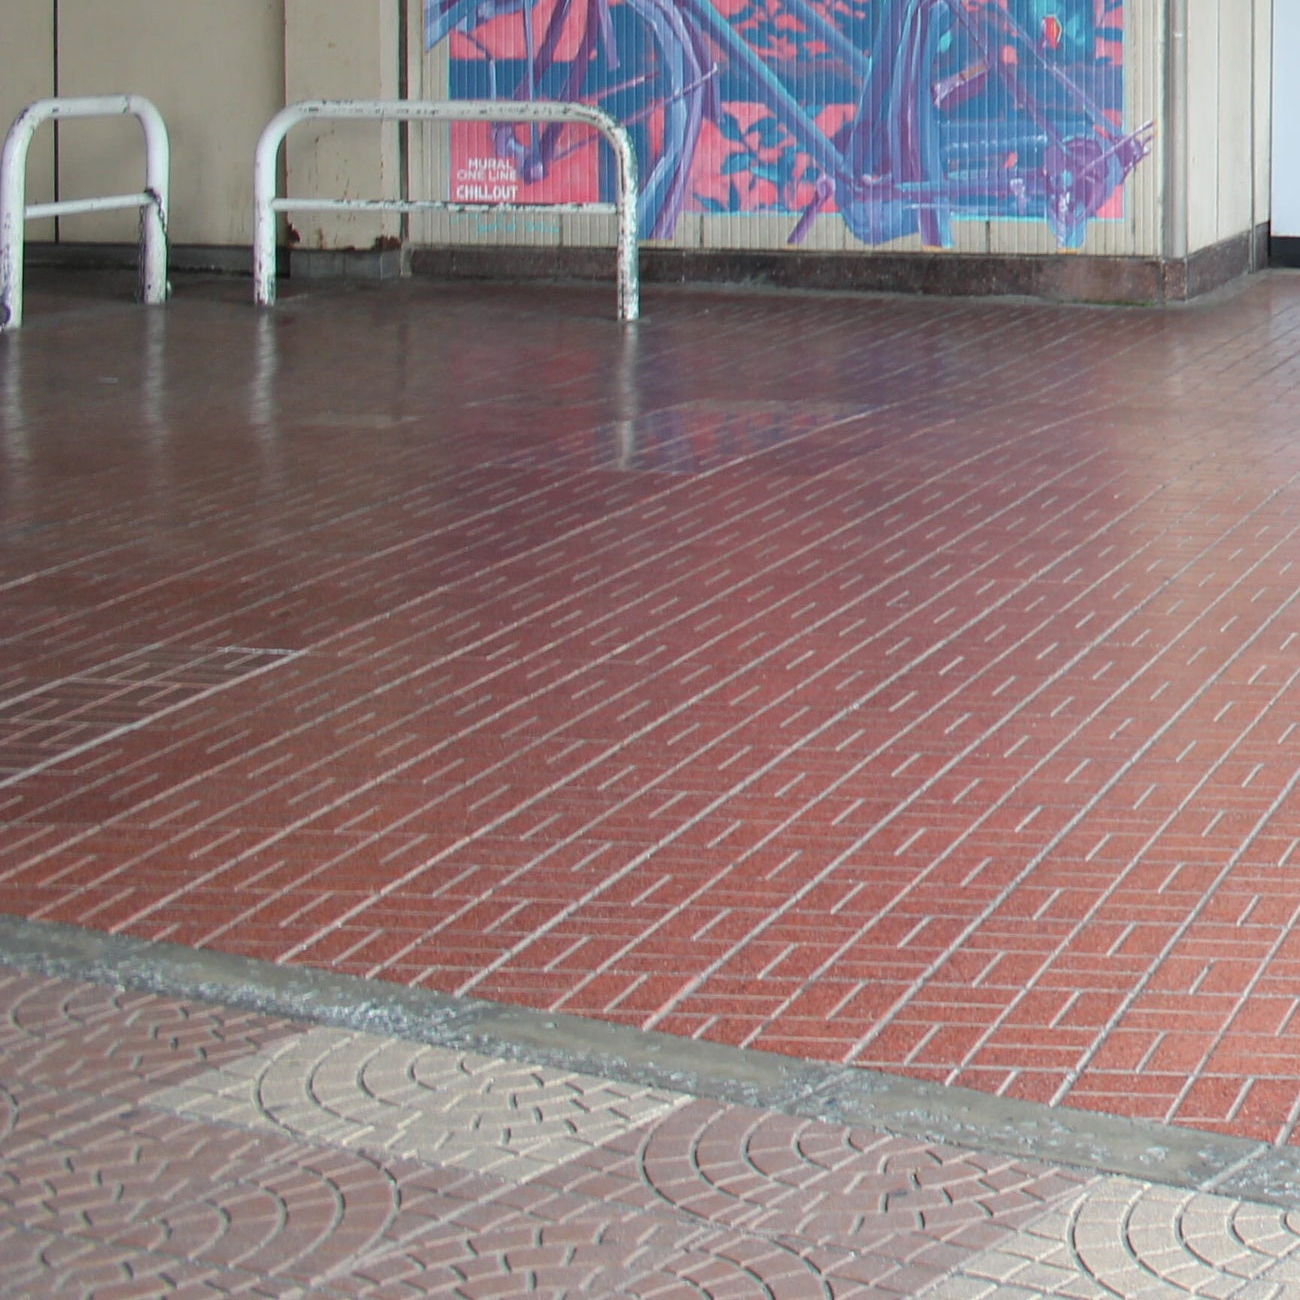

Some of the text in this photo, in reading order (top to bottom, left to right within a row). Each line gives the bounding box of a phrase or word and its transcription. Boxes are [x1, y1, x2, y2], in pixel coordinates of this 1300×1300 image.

[468, 157, 513, 170] MURAL
[456, 169, 518, 181] ONE LINE
[456, 184, 518, 201] CHILLOUT
